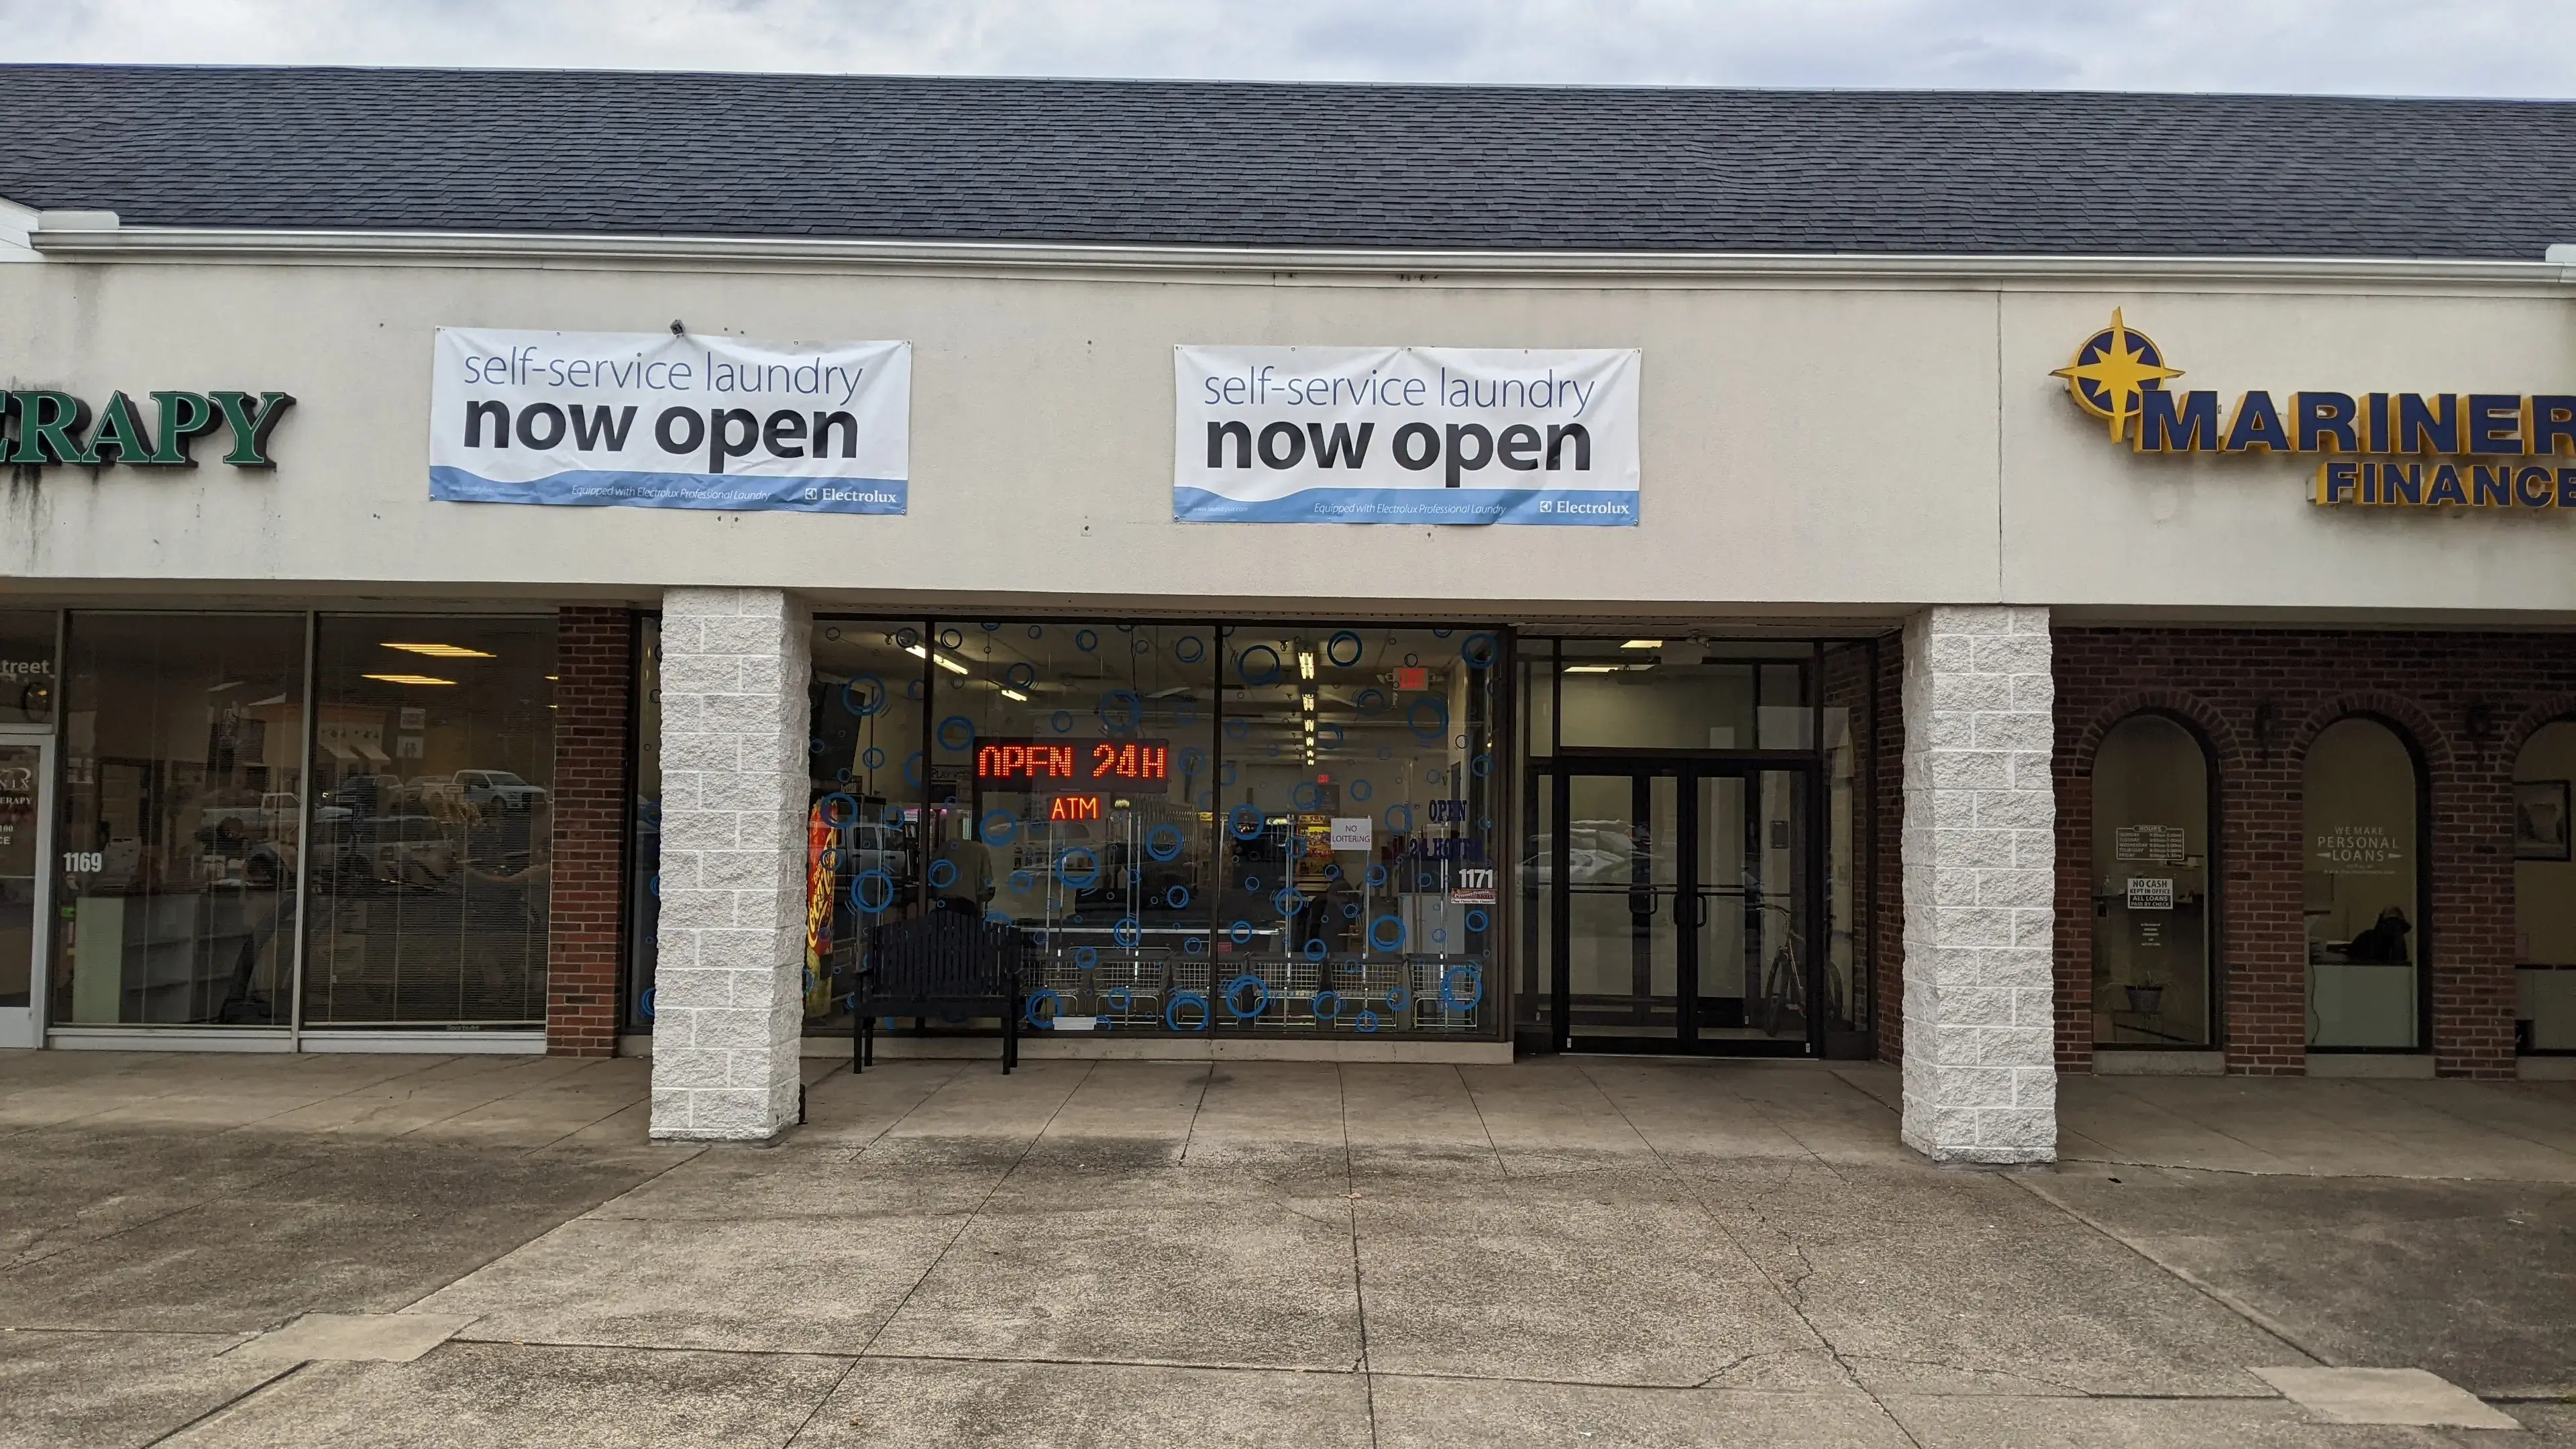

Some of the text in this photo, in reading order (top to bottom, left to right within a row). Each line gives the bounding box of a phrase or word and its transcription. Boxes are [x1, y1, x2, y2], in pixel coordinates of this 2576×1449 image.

[464, 345, 863, 407] self-service laundry
[1204, 366, 1595, 418] self-service laundry
[0, 390, 291, 466] RAPY
[2135, 390, 2576, 455] MARINER
[464, 400, 858, 474] now open
[1207, 421, 1591, 488] now open
[572, 485, 770, 502] Equipped with Electrolux Professional Laundry
[2318, 461, 2576, 508] FINANCE
[822, 488, 897, 502] Electrolux
[1314, 503, 1507, 516] Equipped with Electrolux Professional Laundry
[1556, 500, 1629, 515] Electrolux
[0, 660, 50, 674] treet
[1051, 798, 1098, 820] ATM
[1429, 800, 1466, 822] OPEN
[2334, 826, 2384, 835] WE MAKE
[2318, 837, 2400, 849] PERSONAL
[63, 852, 102, 872] 1169
[2332, 849, 2384, 861] LOANS
[1459, 869, 1493, 889] 1171
